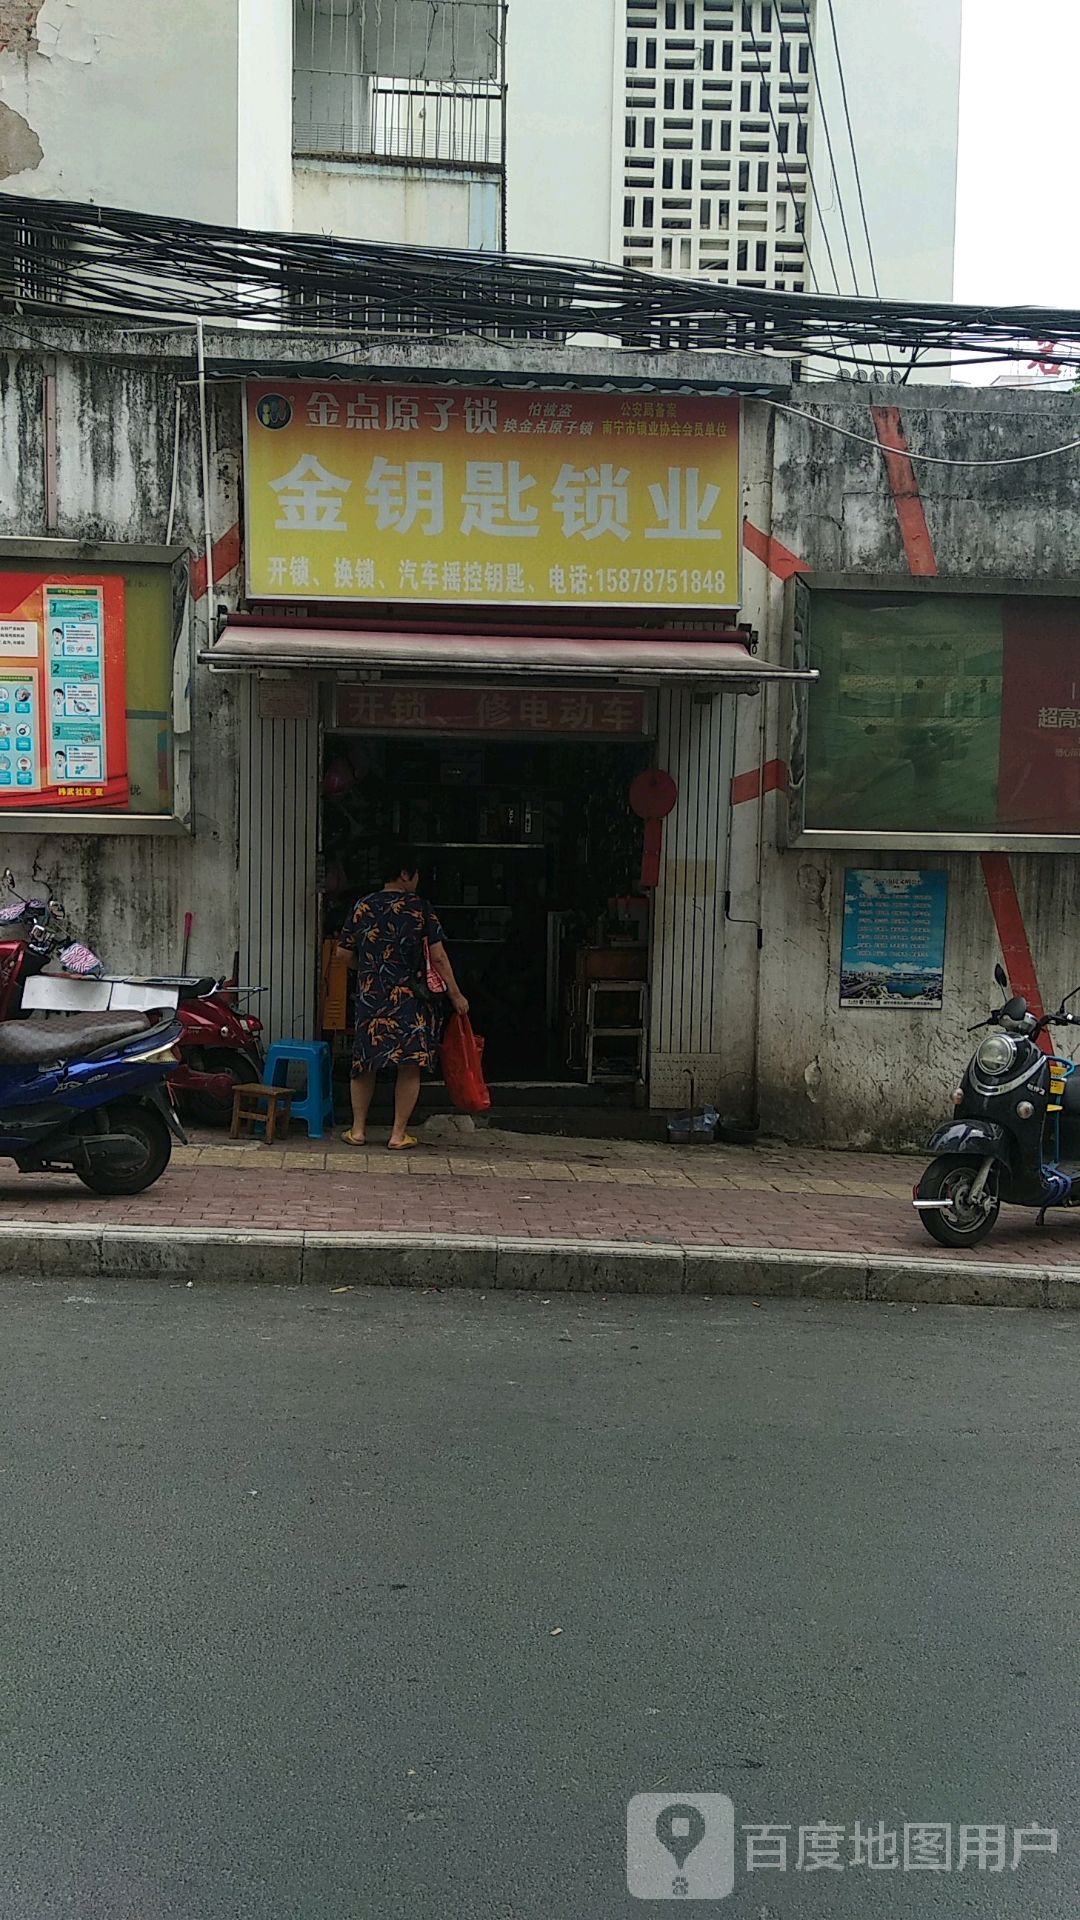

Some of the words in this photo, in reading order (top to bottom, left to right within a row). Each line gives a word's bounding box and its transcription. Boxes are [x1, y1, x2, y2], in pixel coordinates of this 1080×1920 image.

[305, 392, 497, 434] 金点原子锁
[528, 402, 573, 418] 怕被盗
[620, 401, 677, 418] 公安局备案
[502, 418, 594, 436] 换金点原子锁
[601, 419, 728, 438] 南宁市锁业协会会员单位
[268, 454, 723, 541] 金钥匙锁业
[1038, 707, 1080, 729] 超高
